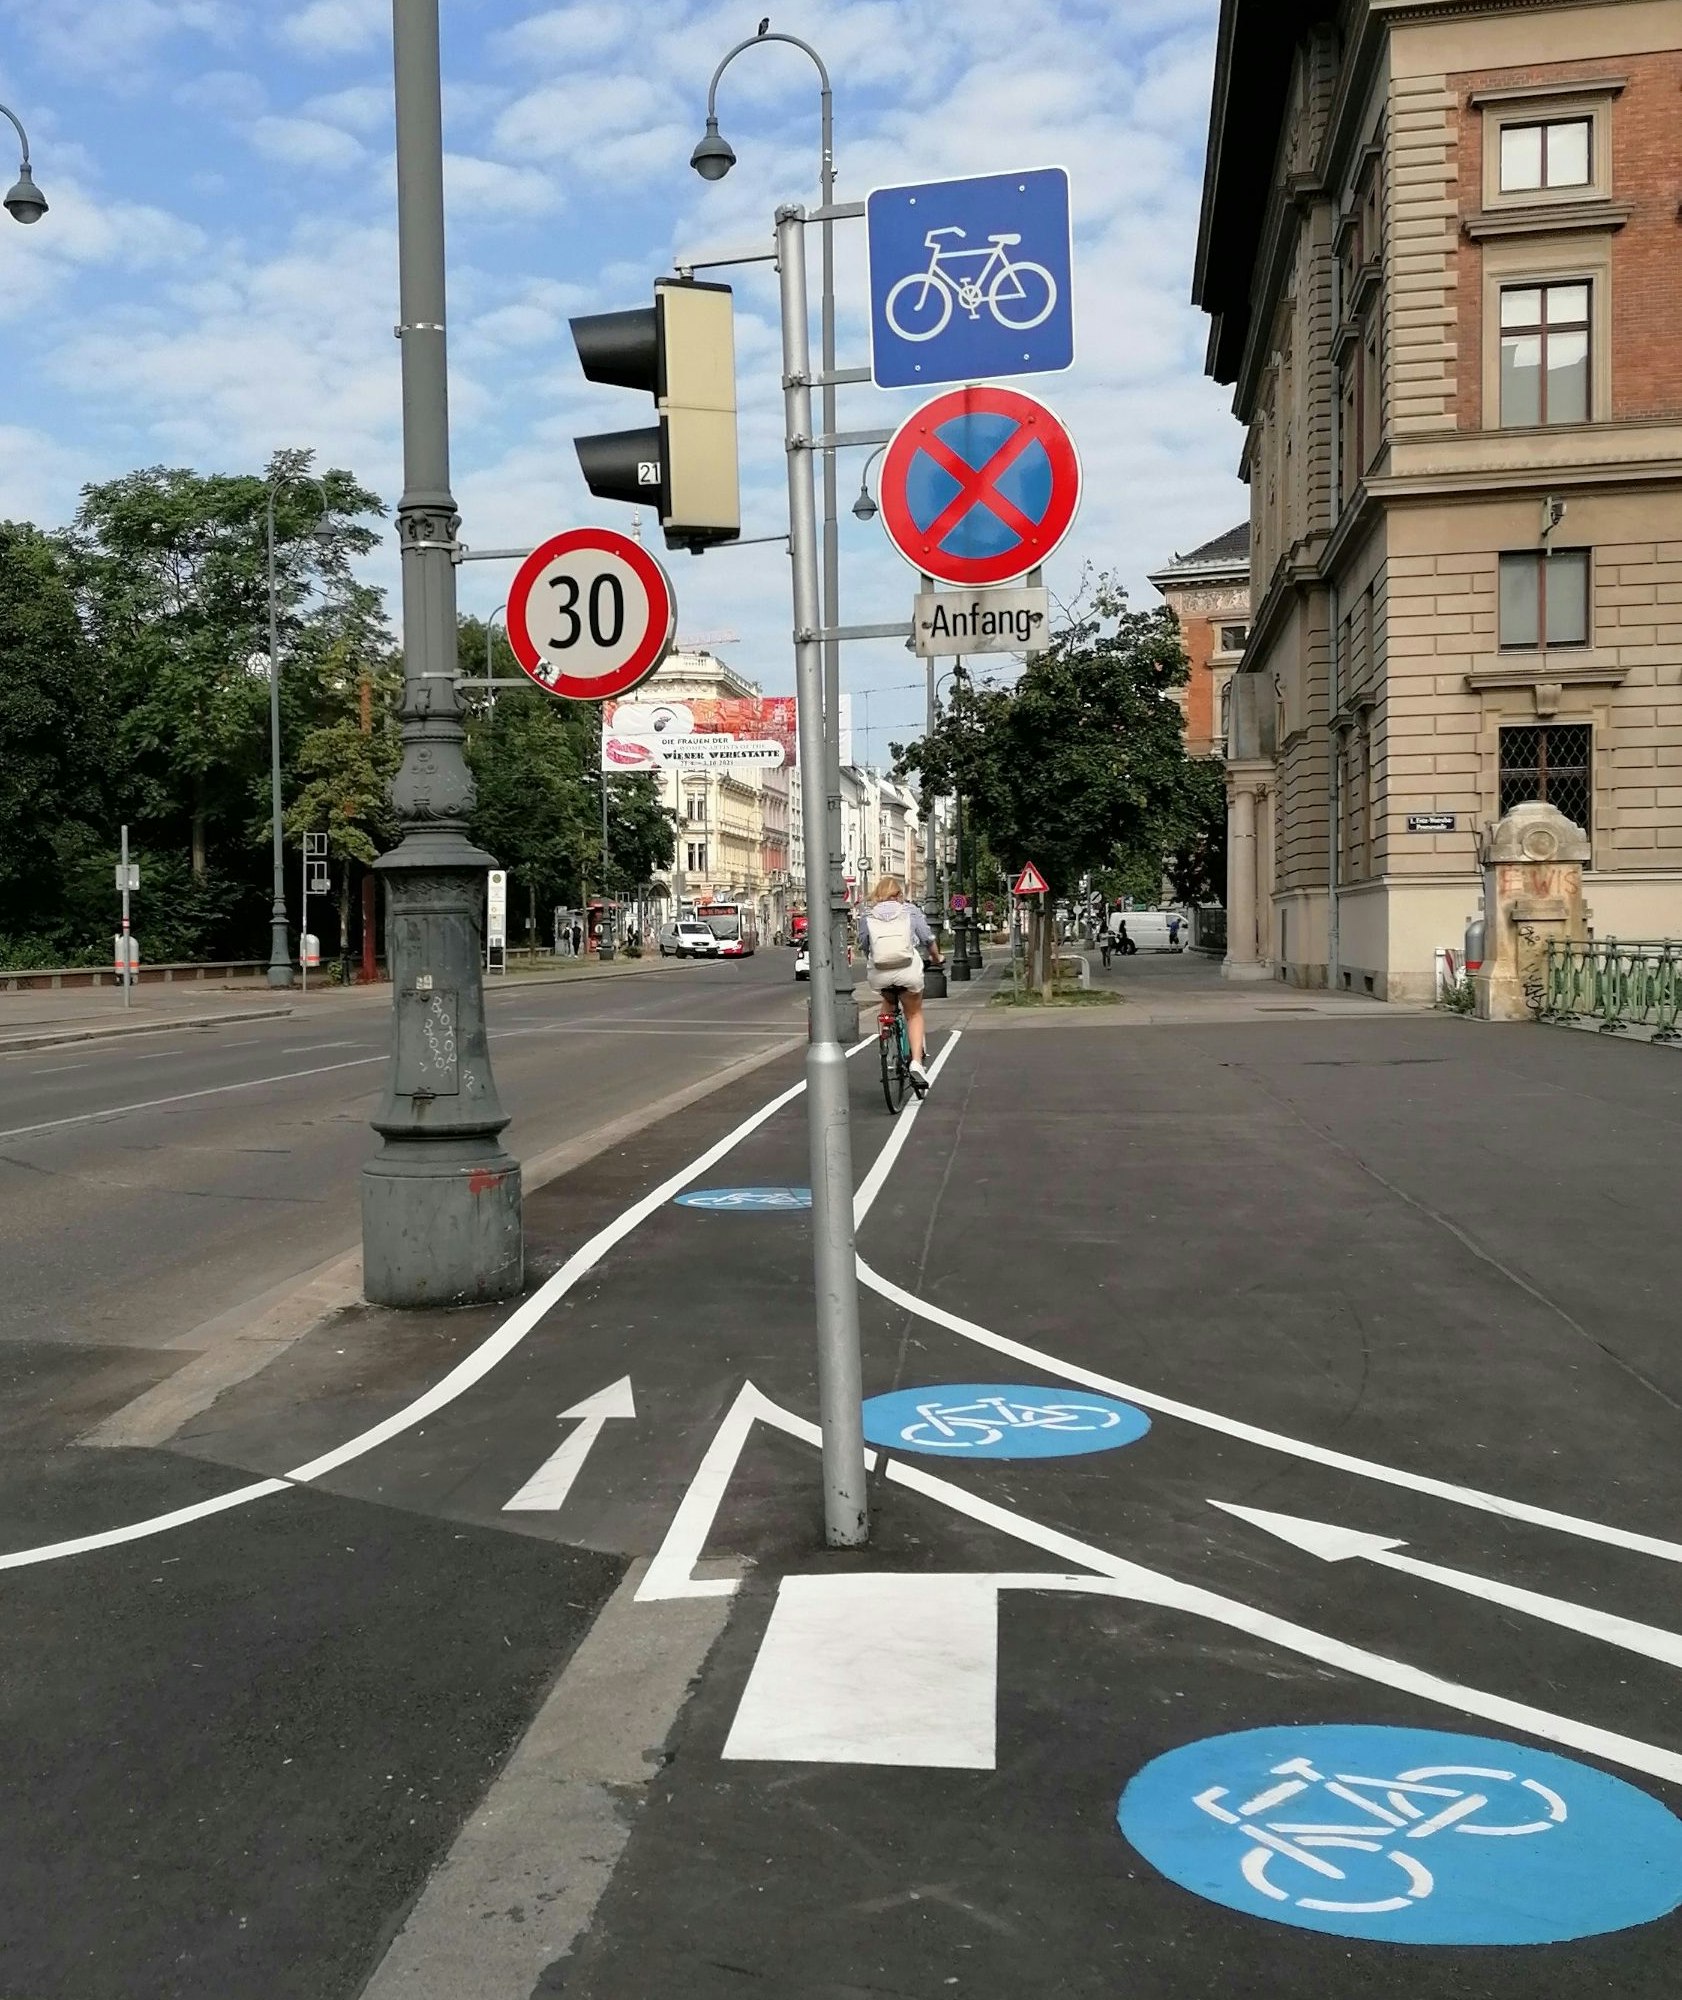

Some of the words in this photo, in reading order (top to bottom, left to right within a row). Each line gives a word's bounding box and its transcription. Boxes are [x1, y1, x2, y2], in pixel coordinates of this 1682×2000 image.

[640, 464, 659, 482] 21
[548, 573, 624, 649] 30
[931, 602, 1031, 642] Anfang
[677, 737, 710, 745] FRAUEN
